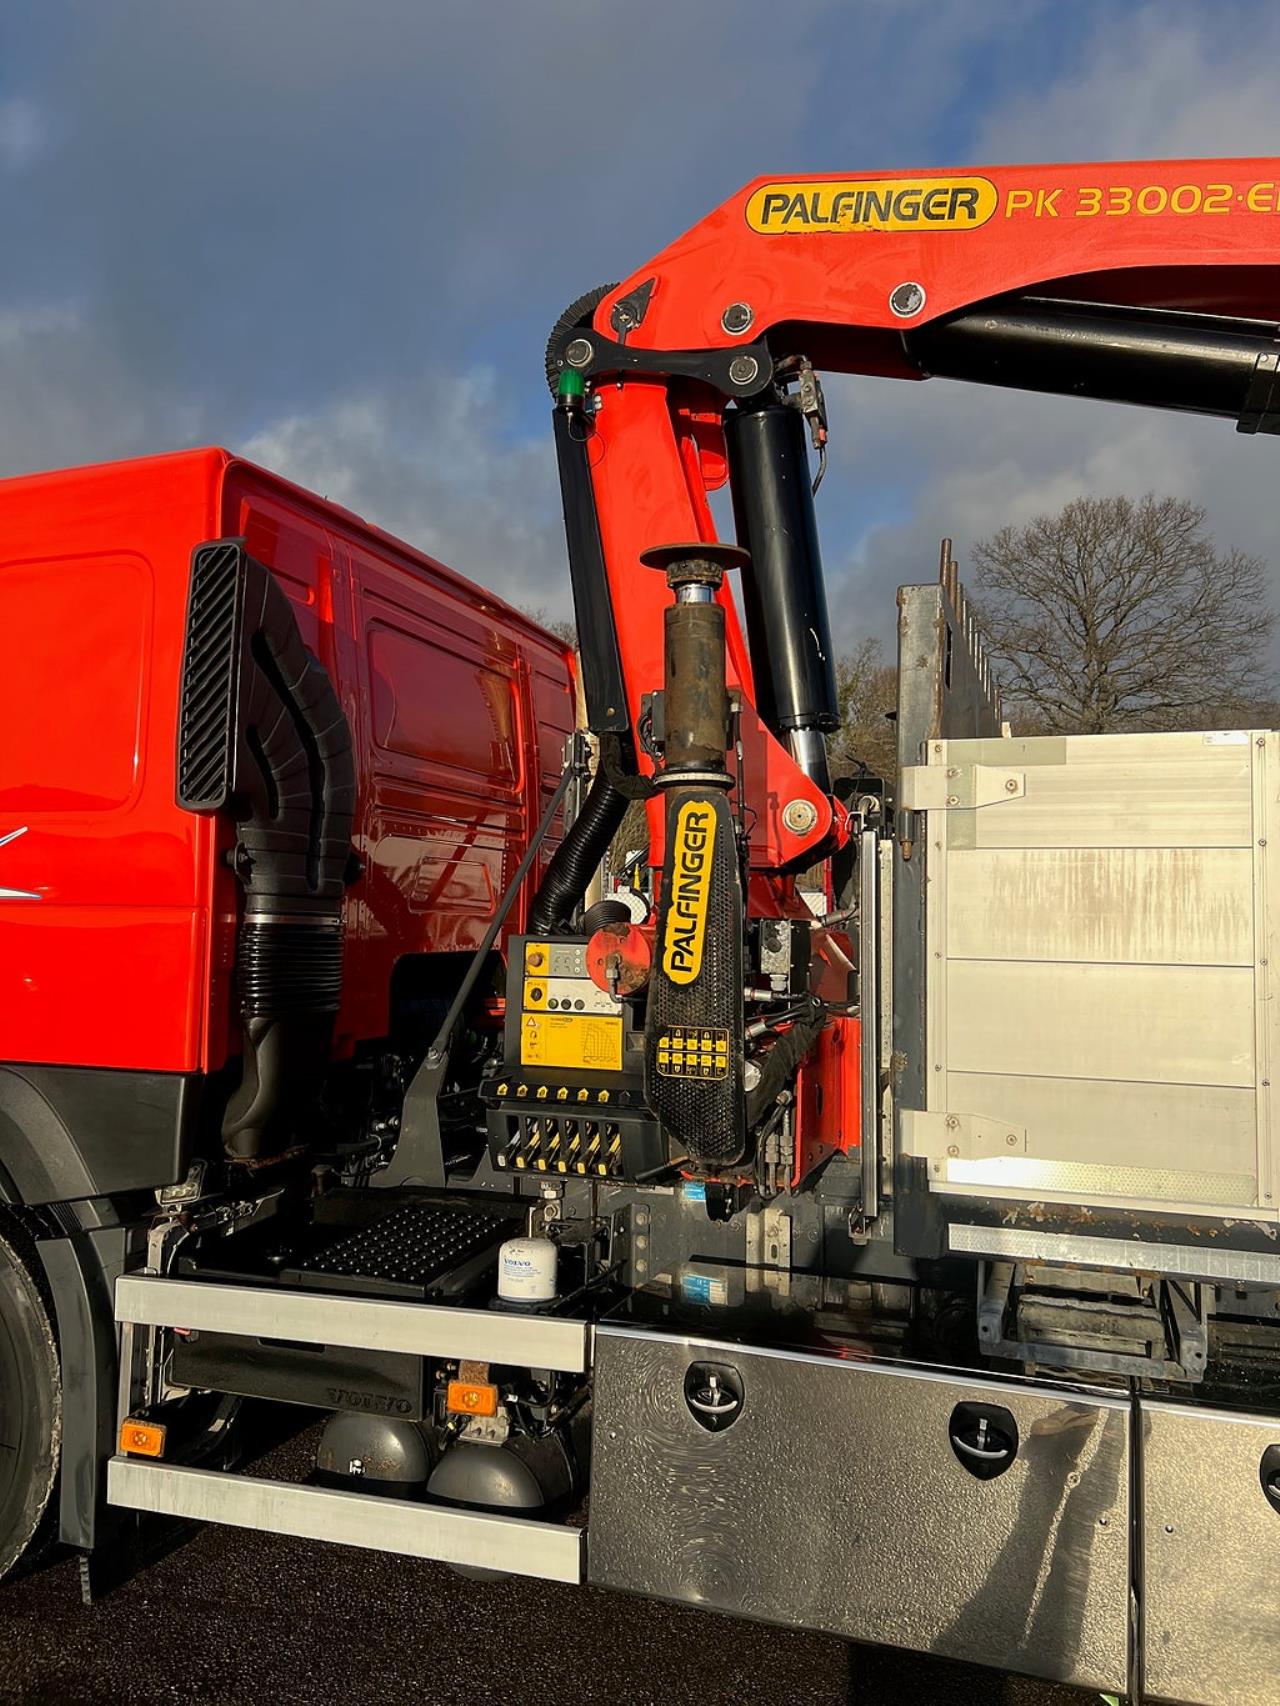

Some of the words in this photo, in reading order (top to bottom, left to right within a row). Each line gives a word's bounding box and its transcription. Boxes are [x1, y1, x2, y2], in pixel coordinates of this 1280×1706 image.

[761, 187, 980, 225] PALFINGER
[1005, 188, 1064, 218] PK
[1075, 182, 1280, 216] 33002·E
[670, 811, 709, 973] PALFINGER
[504, 1258, 531, 1266] VOLVO
[326, 1387, 412, 1414] VOLVO
